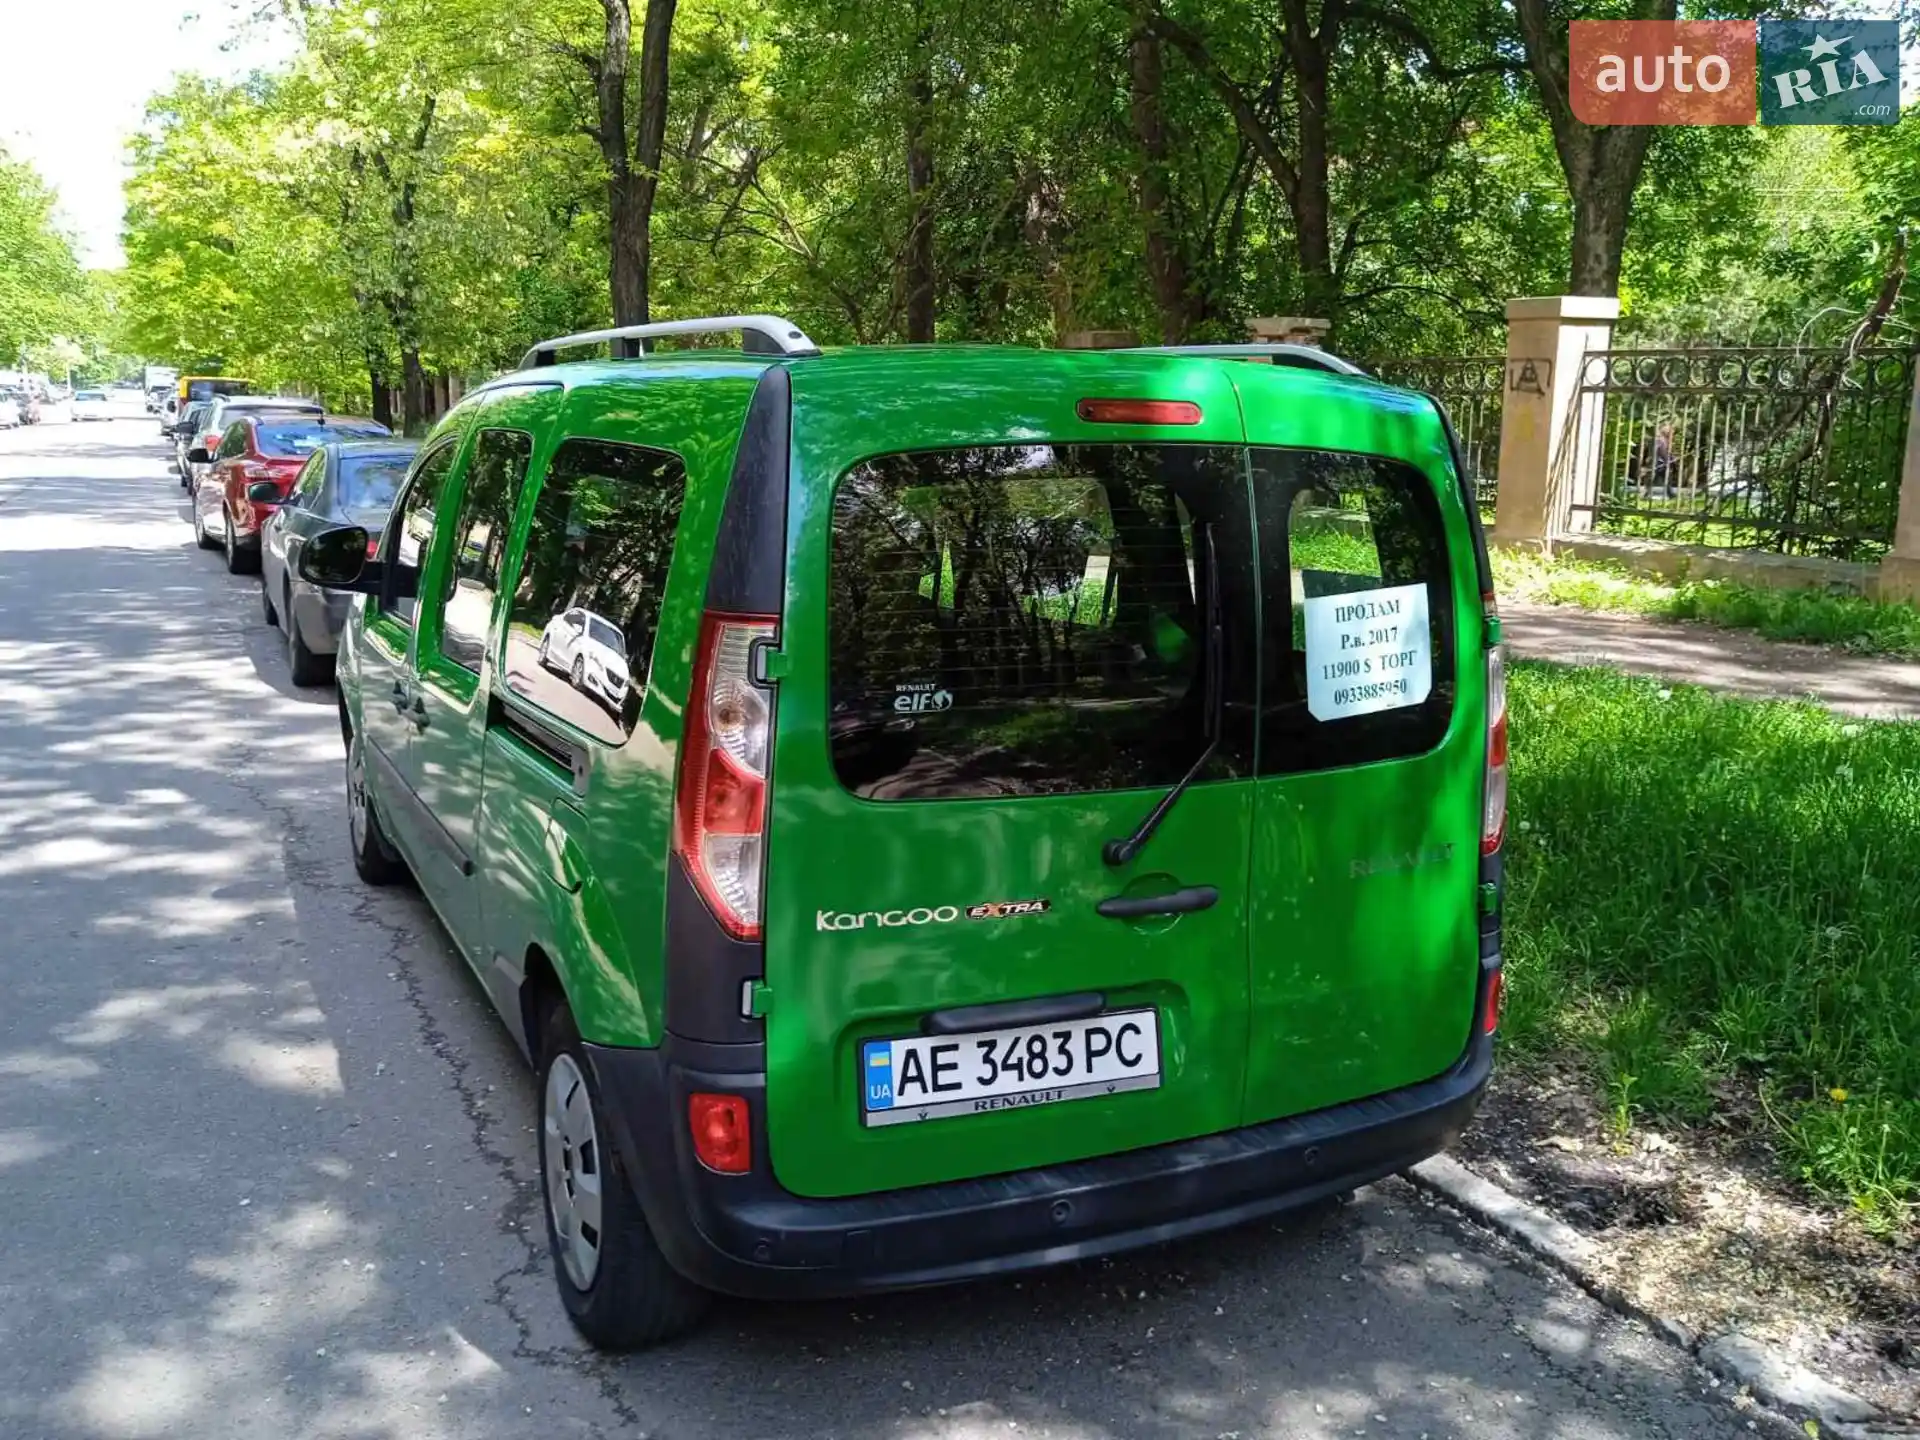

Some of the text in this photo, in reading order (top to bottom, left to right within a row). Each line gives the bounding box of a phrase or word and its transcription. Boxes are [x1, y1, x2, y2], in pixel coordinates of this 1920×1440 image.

[1335, 599, 1400, 623] ПРОДАМ
[1369, 626, 1398, 646] 2017
[1322, 659, 1360, 680] 11900
[1379, 650, 1417, 671] ТОРГ
[896, 683, 936, 692] RENAULT
[897, 1022, 1143, 1096] AE 3483 PC
[871, 1084, 892, 1099] UA
[974, 1089, 1069, 1111] RENAULT
